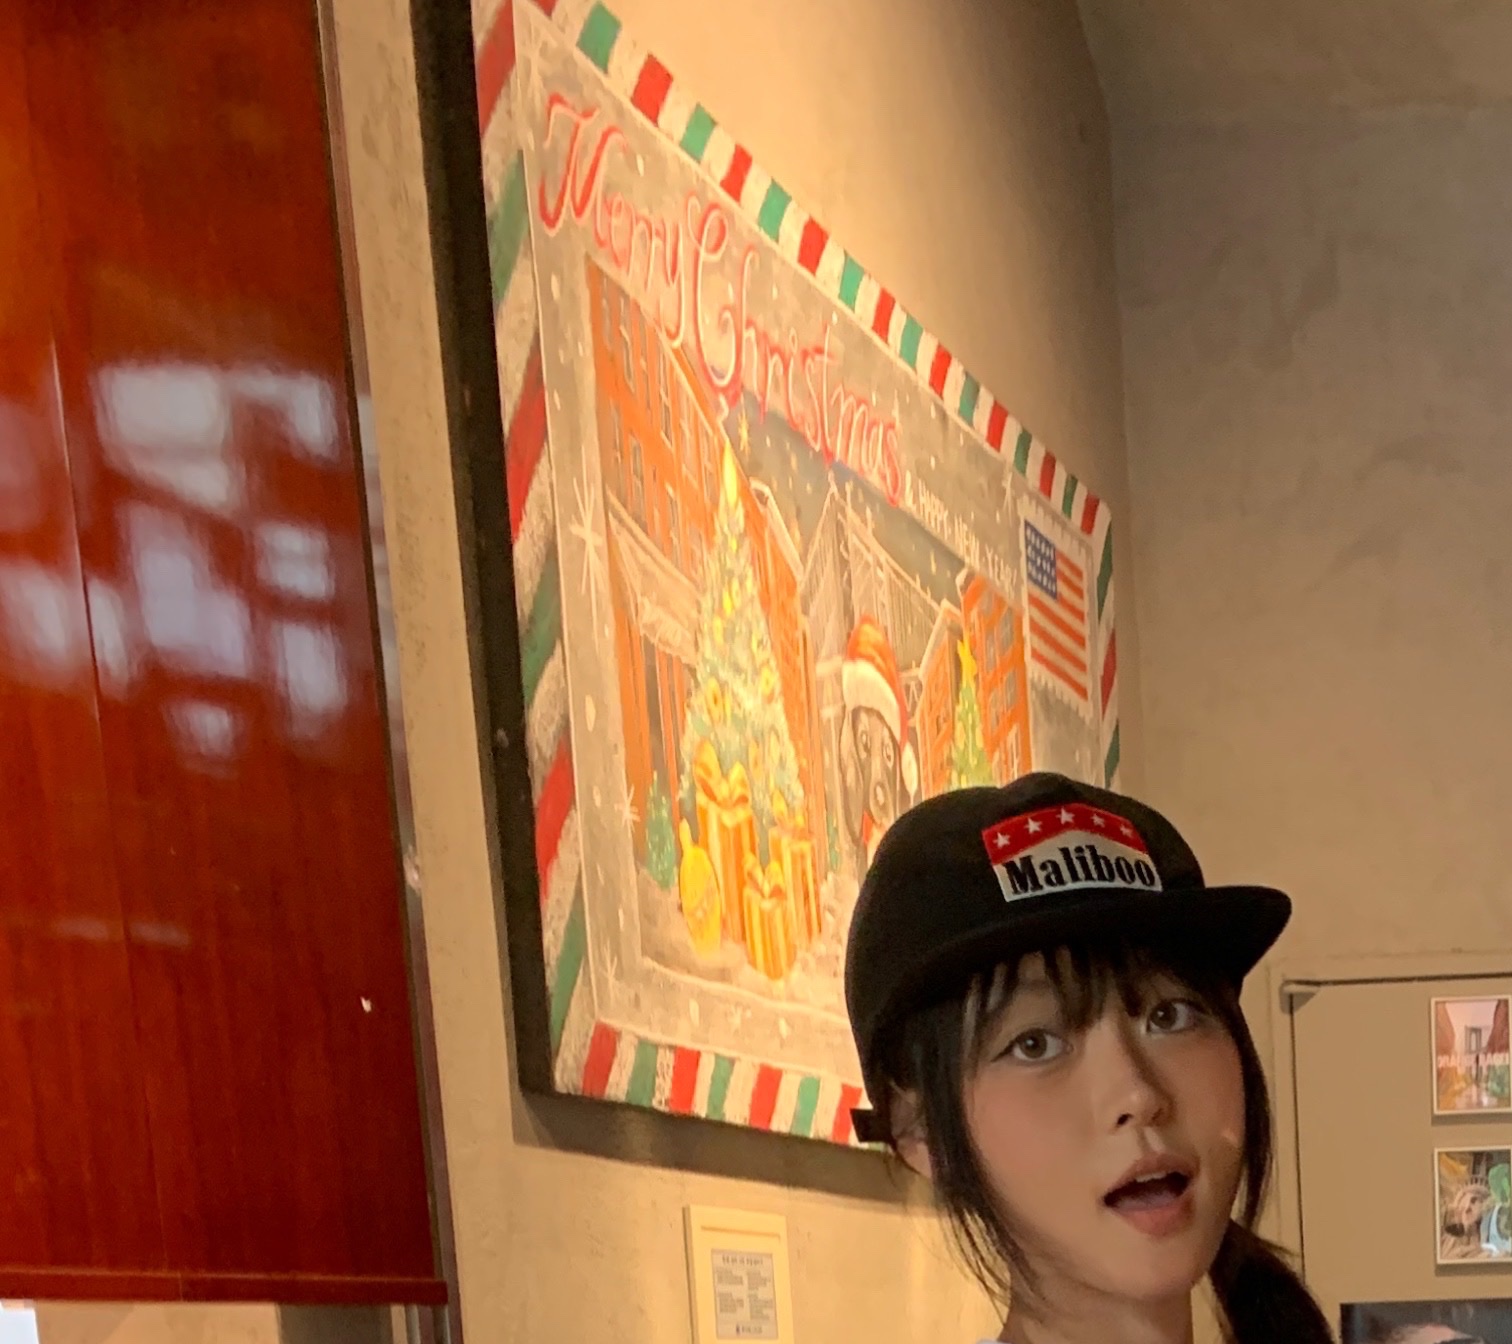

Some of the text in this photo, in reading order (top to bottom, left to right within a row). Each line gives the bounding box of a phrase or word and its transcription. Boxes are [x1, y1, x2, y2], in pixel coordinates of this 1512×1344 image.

[539, 92, 903, 508] Merry Christmas
[1003, 845, 1156, 895] Maliboo
